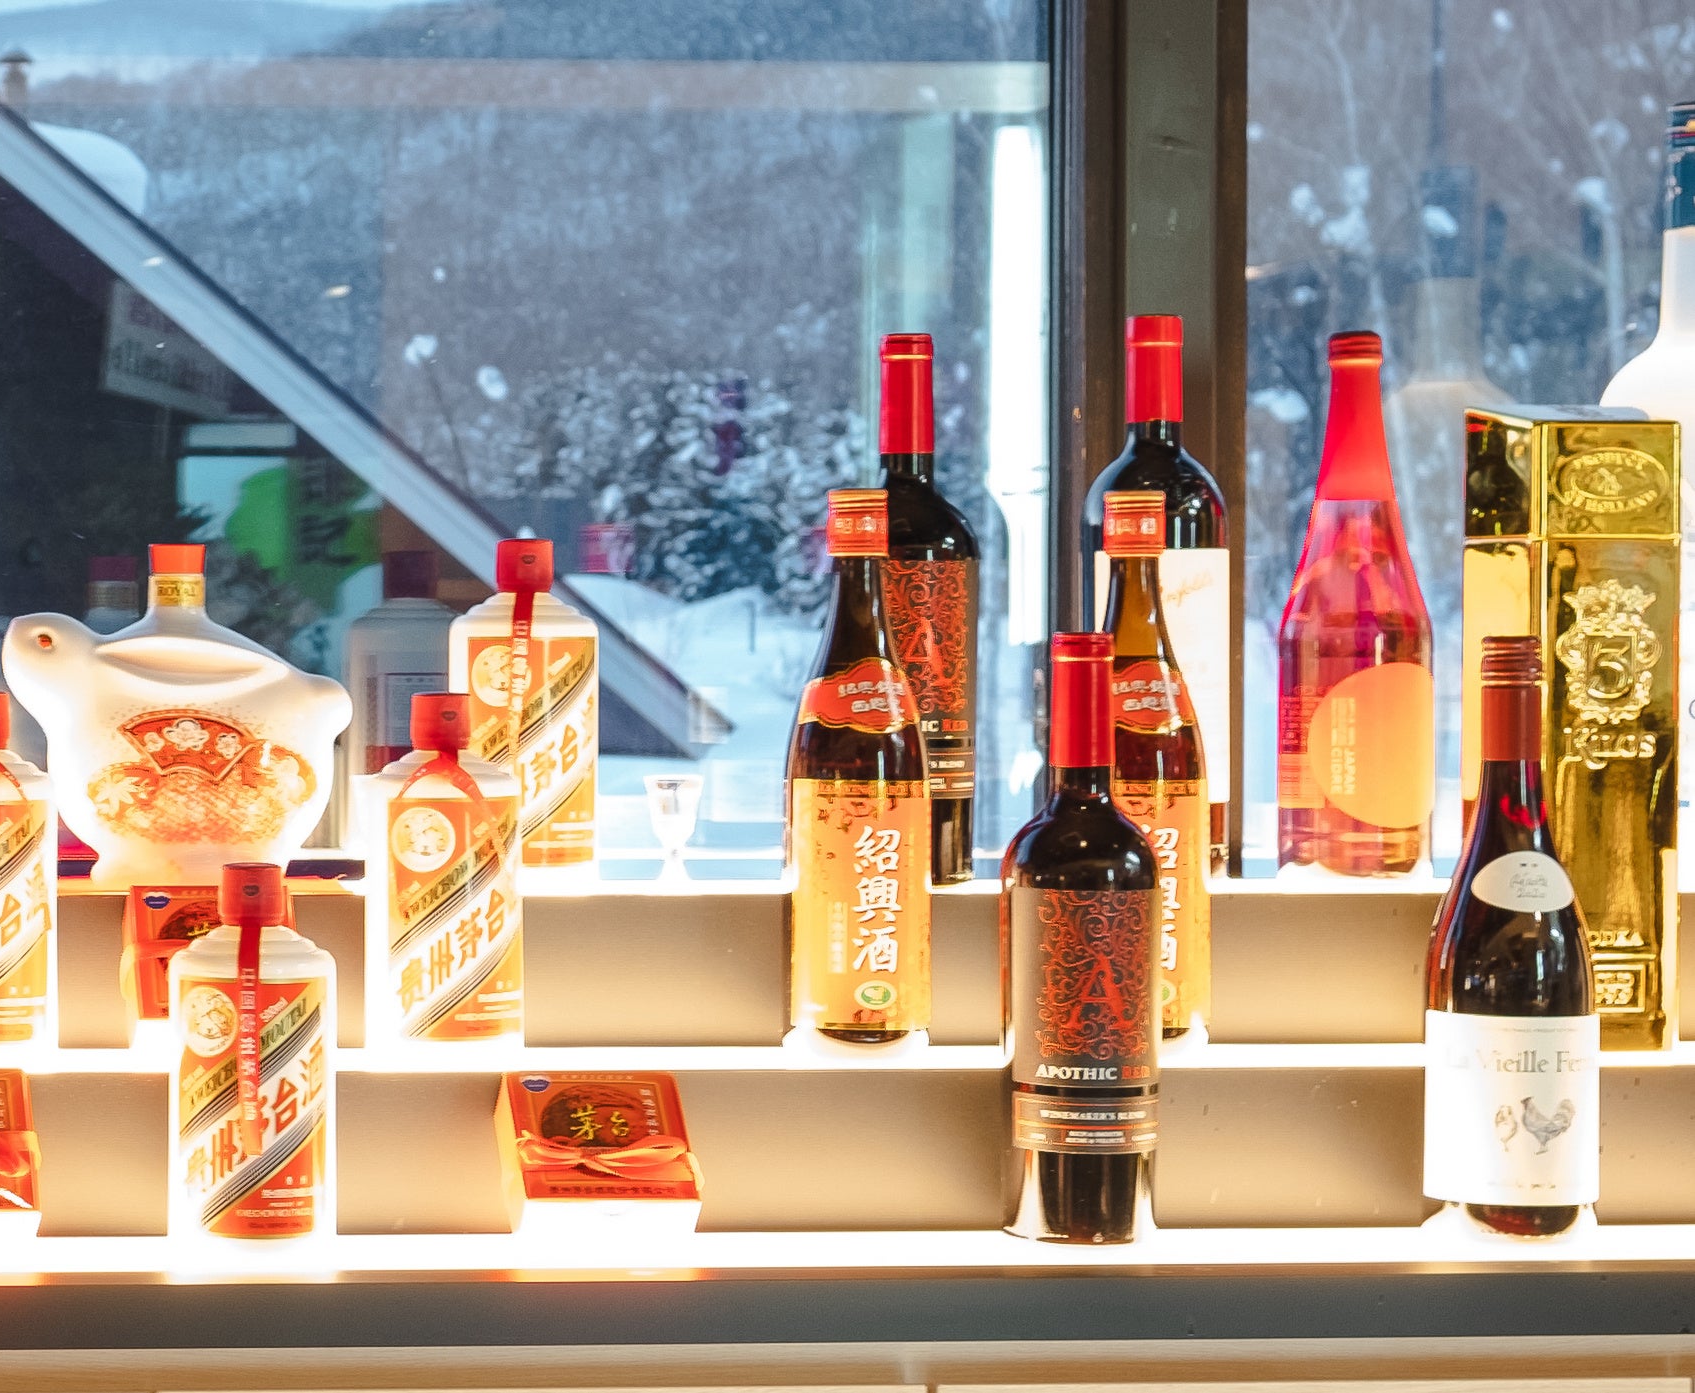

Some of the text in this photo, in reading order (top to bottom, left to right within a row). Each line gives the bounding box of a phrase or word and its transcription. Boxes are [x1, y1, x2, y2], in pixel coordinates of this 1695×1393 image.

[851, 824, 903, 975] 紹興酒
[397, 889, 508, 1016] 贵州茅台
[1587, 929, 1646, 948] ODKA
[1035, 1064, 1118, 1080] APOTHIC
[570, 1103, 630, 1140] 茅台
